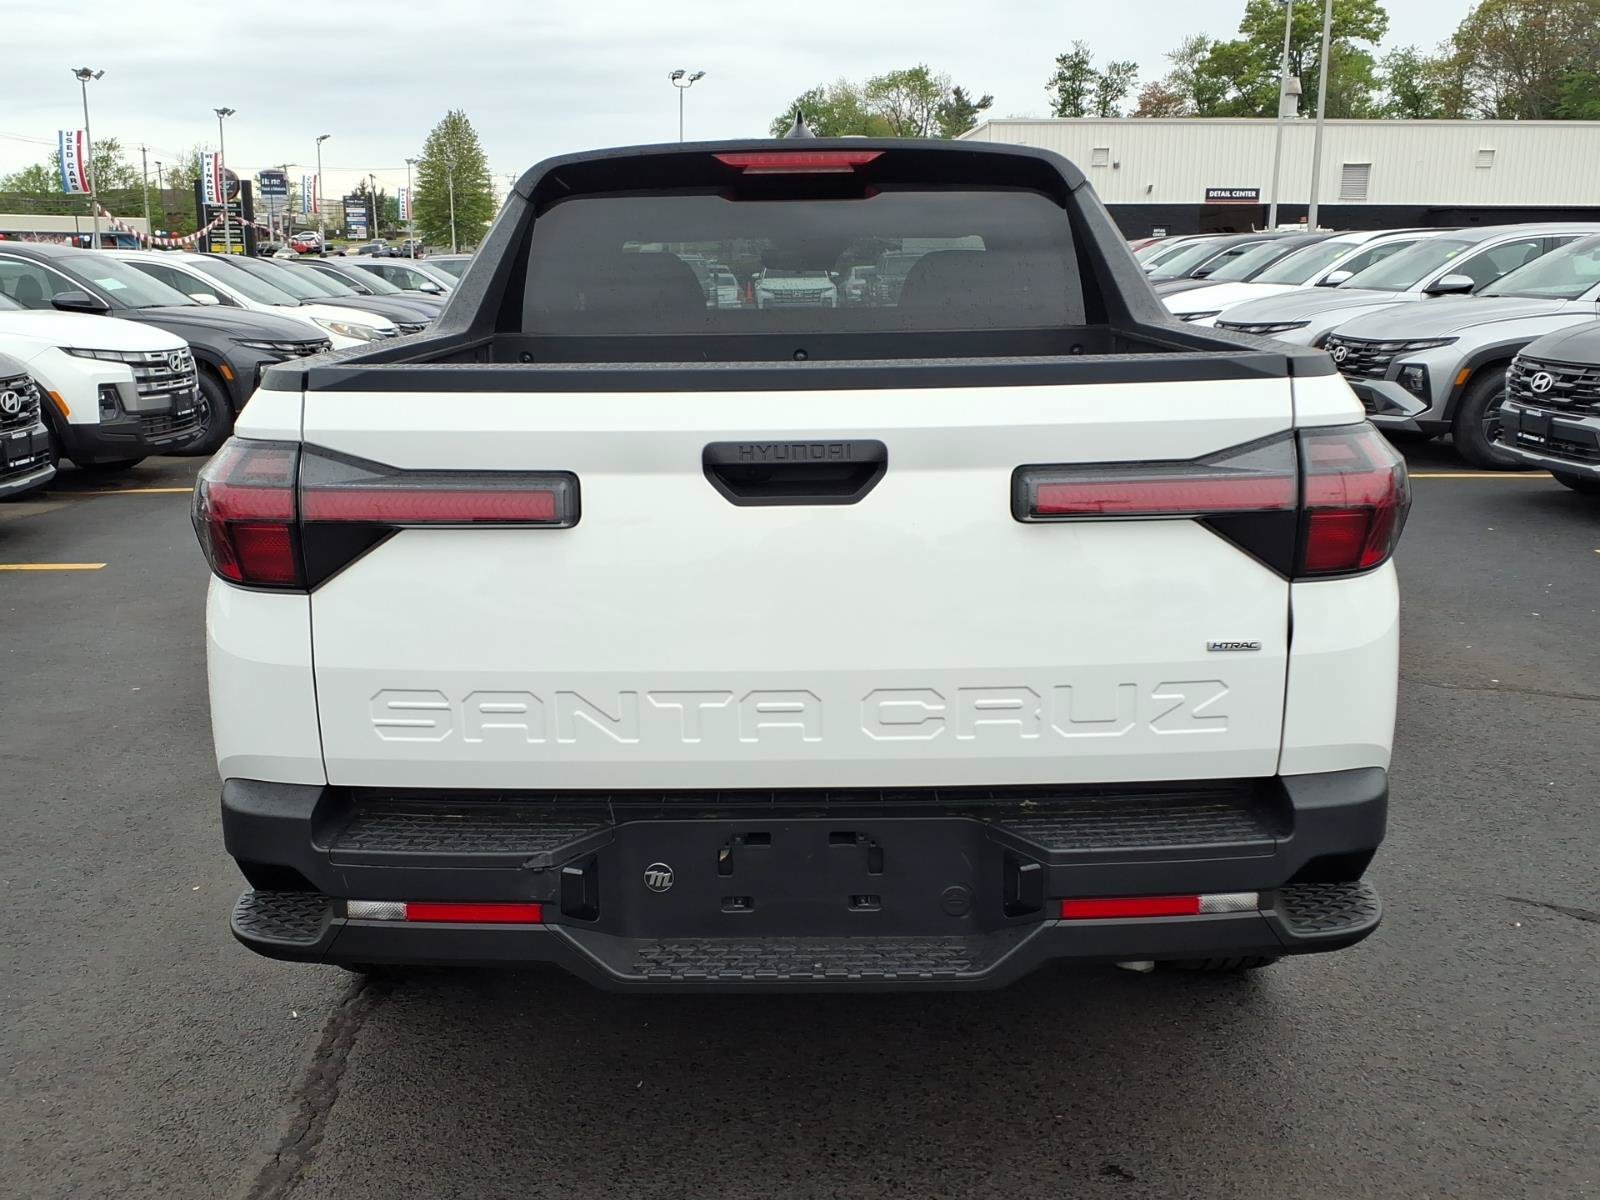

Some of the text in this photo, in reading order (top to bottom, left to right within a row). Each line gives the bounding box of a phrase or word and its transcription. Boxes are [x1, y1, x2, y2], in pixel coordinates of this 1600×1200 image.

[67, 163, 79, 190] CARS
[739, 443, 851, 462] HYUNDAI
[1212, 641, 1258, 649] HTRAC
[370, 679, 1229, 744] SANTA CRUZ
